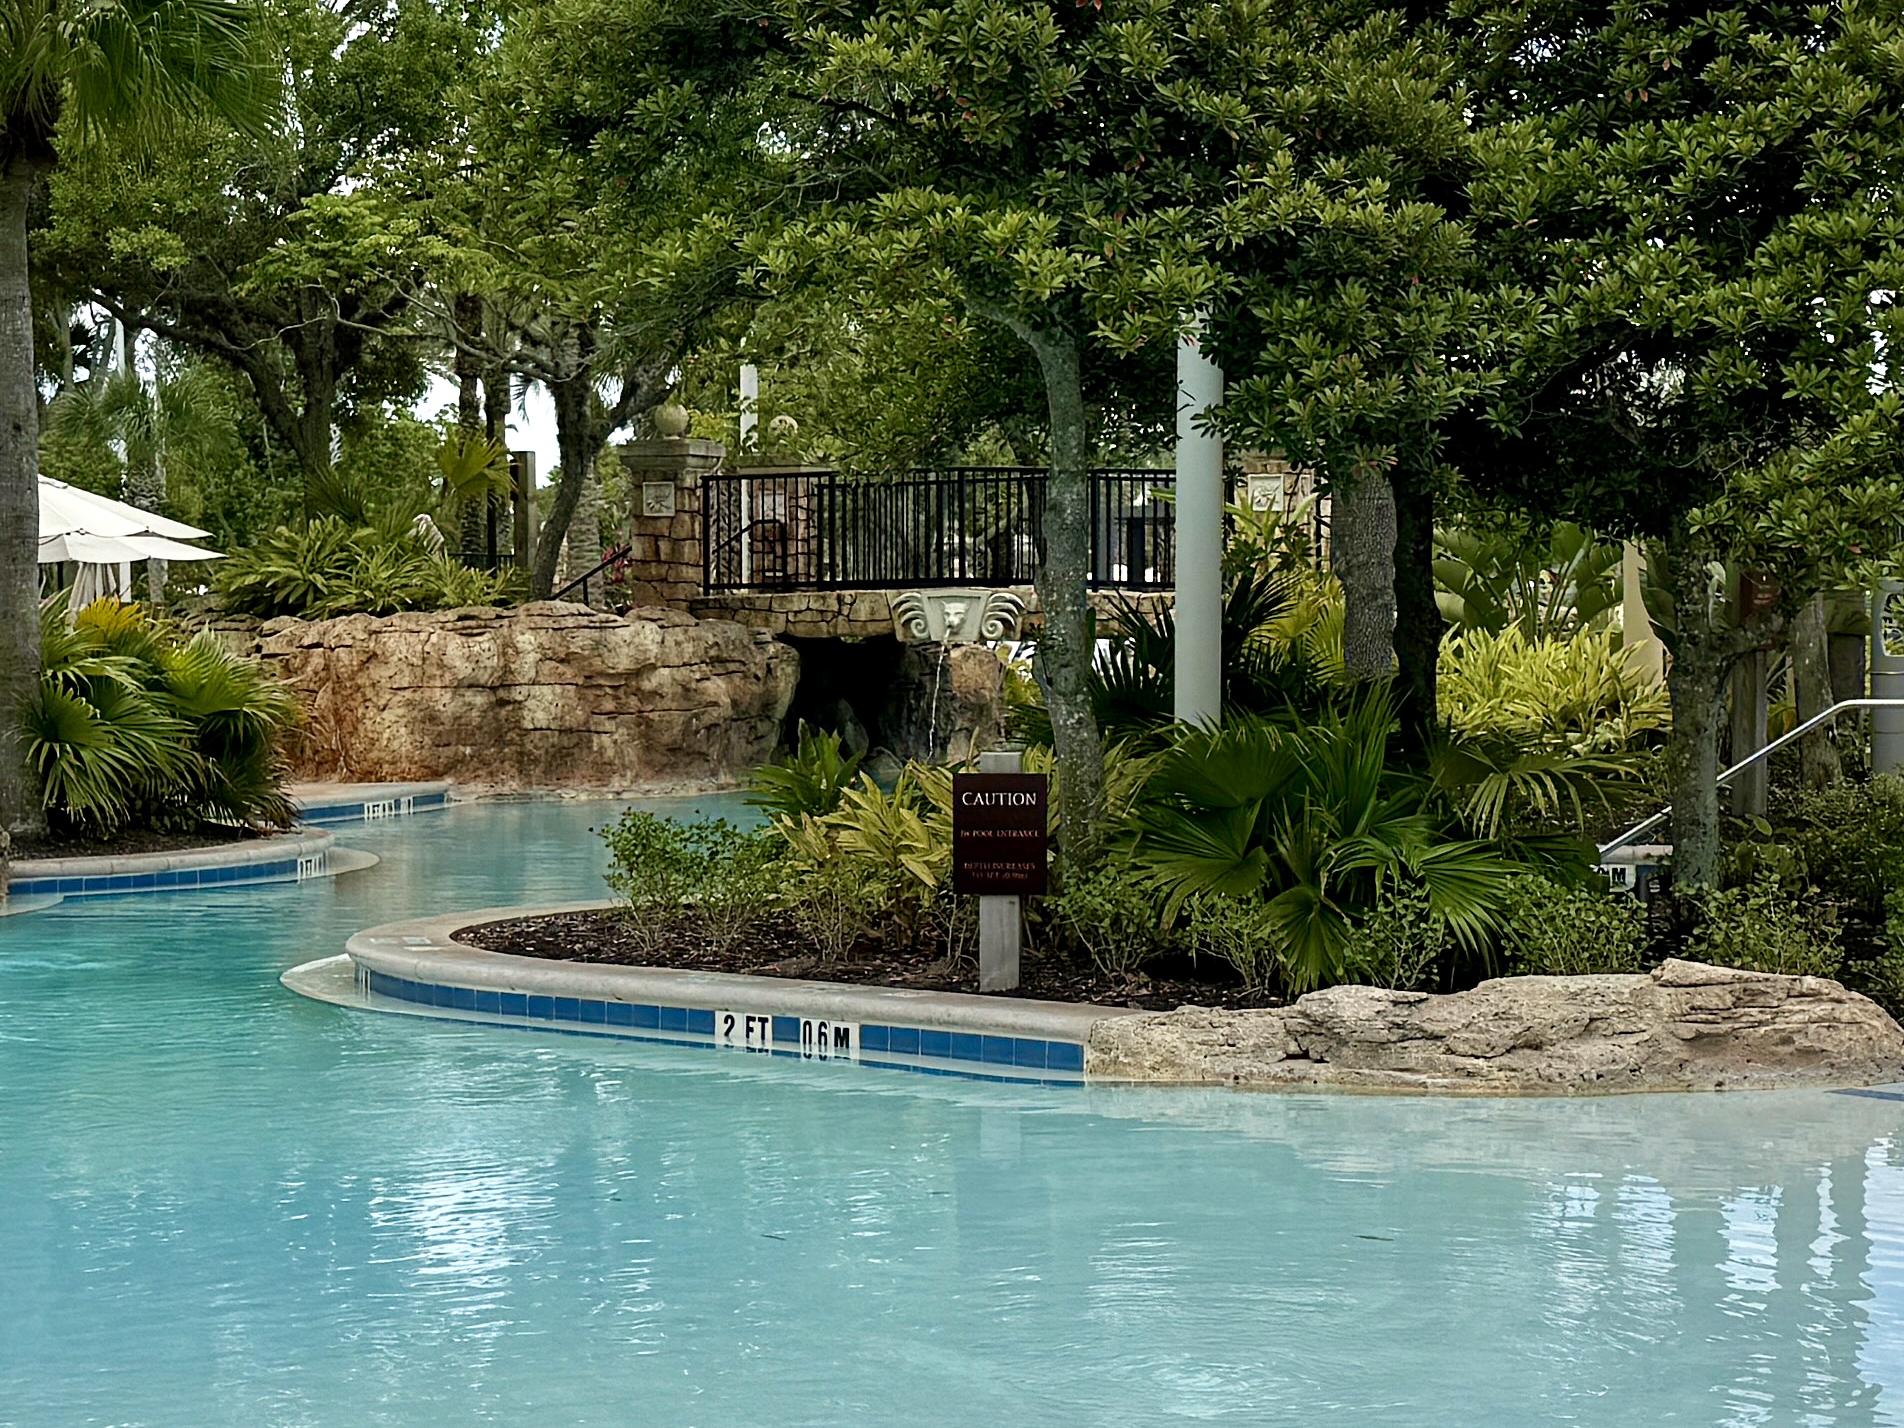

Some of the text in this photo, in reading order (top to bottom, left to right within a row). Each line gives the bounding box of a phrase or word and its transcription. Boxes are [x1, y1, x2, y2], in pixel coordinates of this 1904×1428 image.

[962, 791, 1036, 807] CAUTION
[723, 1014, 736, 1037] 2
[745, 1015, 770, 1041] FT
[833, 1026, 851, 1049] M
